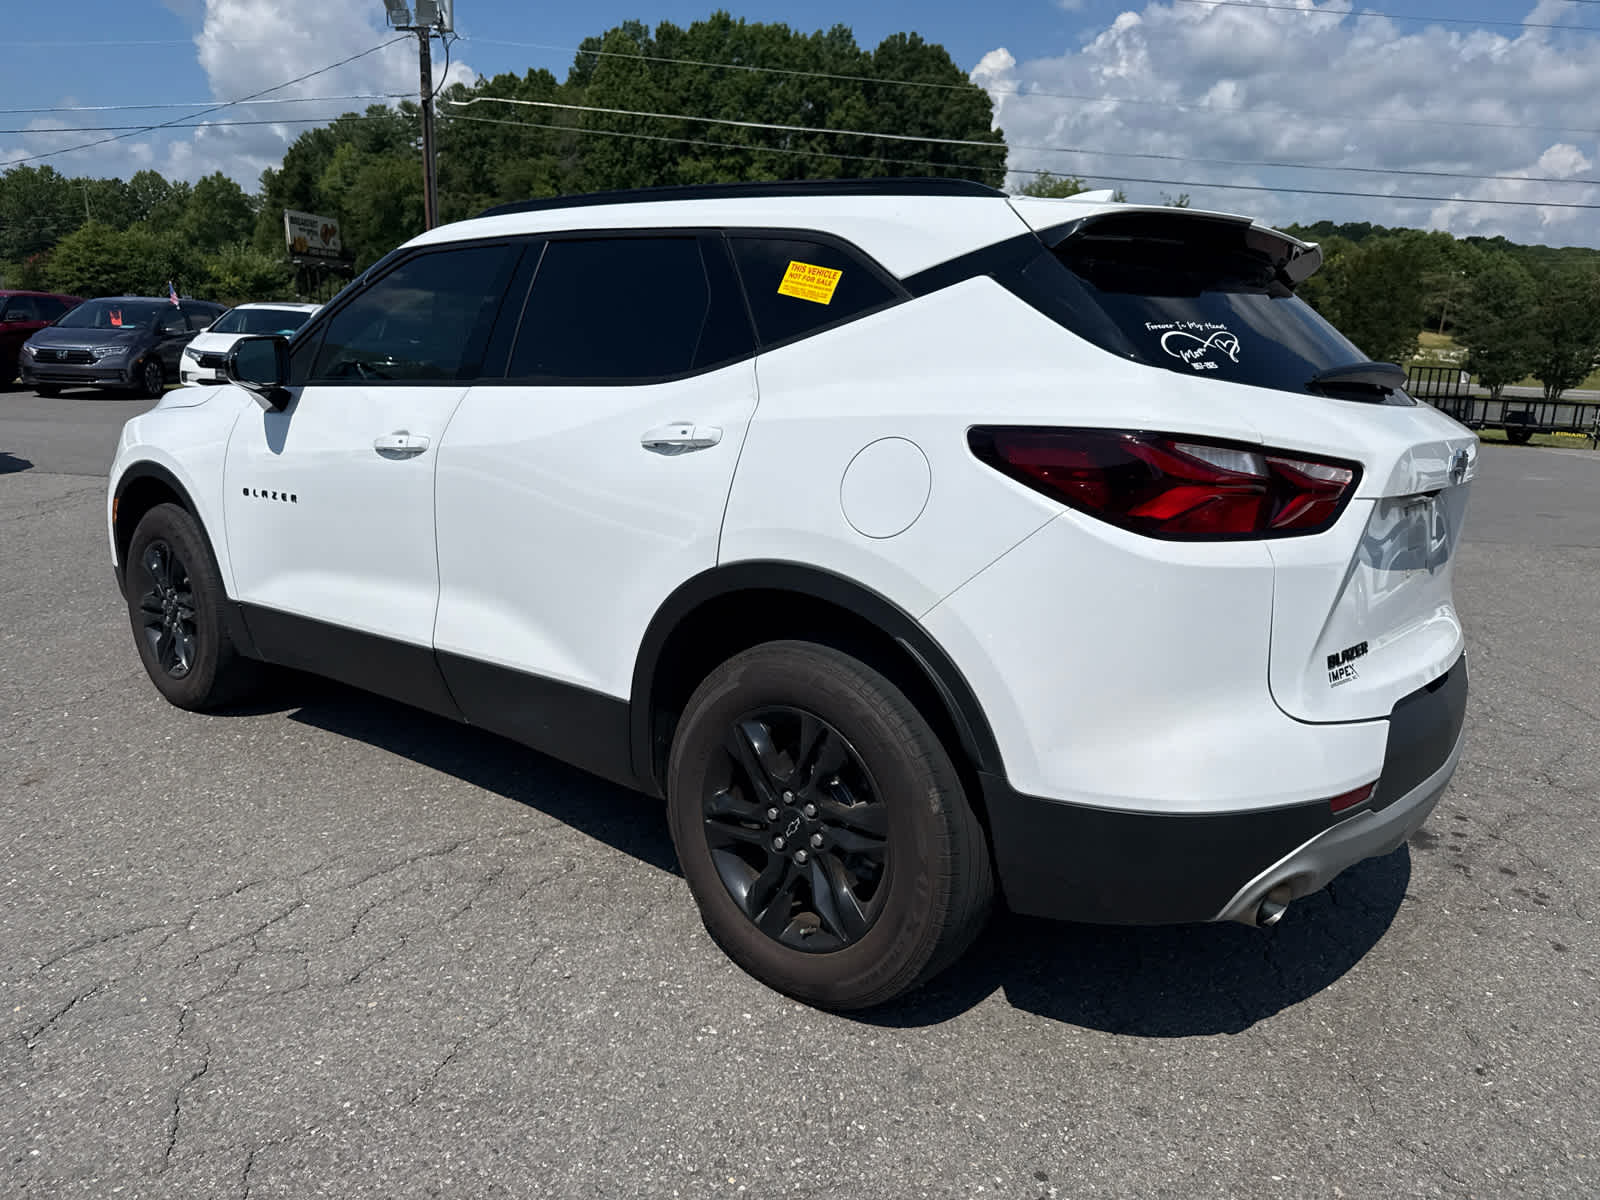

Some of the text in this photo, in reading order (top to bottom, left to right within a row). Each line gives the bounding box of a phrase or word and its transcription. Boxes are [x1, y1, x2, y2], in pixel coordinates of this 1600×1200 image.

[791, 263, 839, 280] THIS VEHICLE
[816, 278, 834, 287] SALE
[1187, 321, 1204, 331] My
[242, 487, 298, 504] BLAZER
[1327, 640, 1369, 670] BLAZER
[1328, 663, 1360, 683] IMPEX
